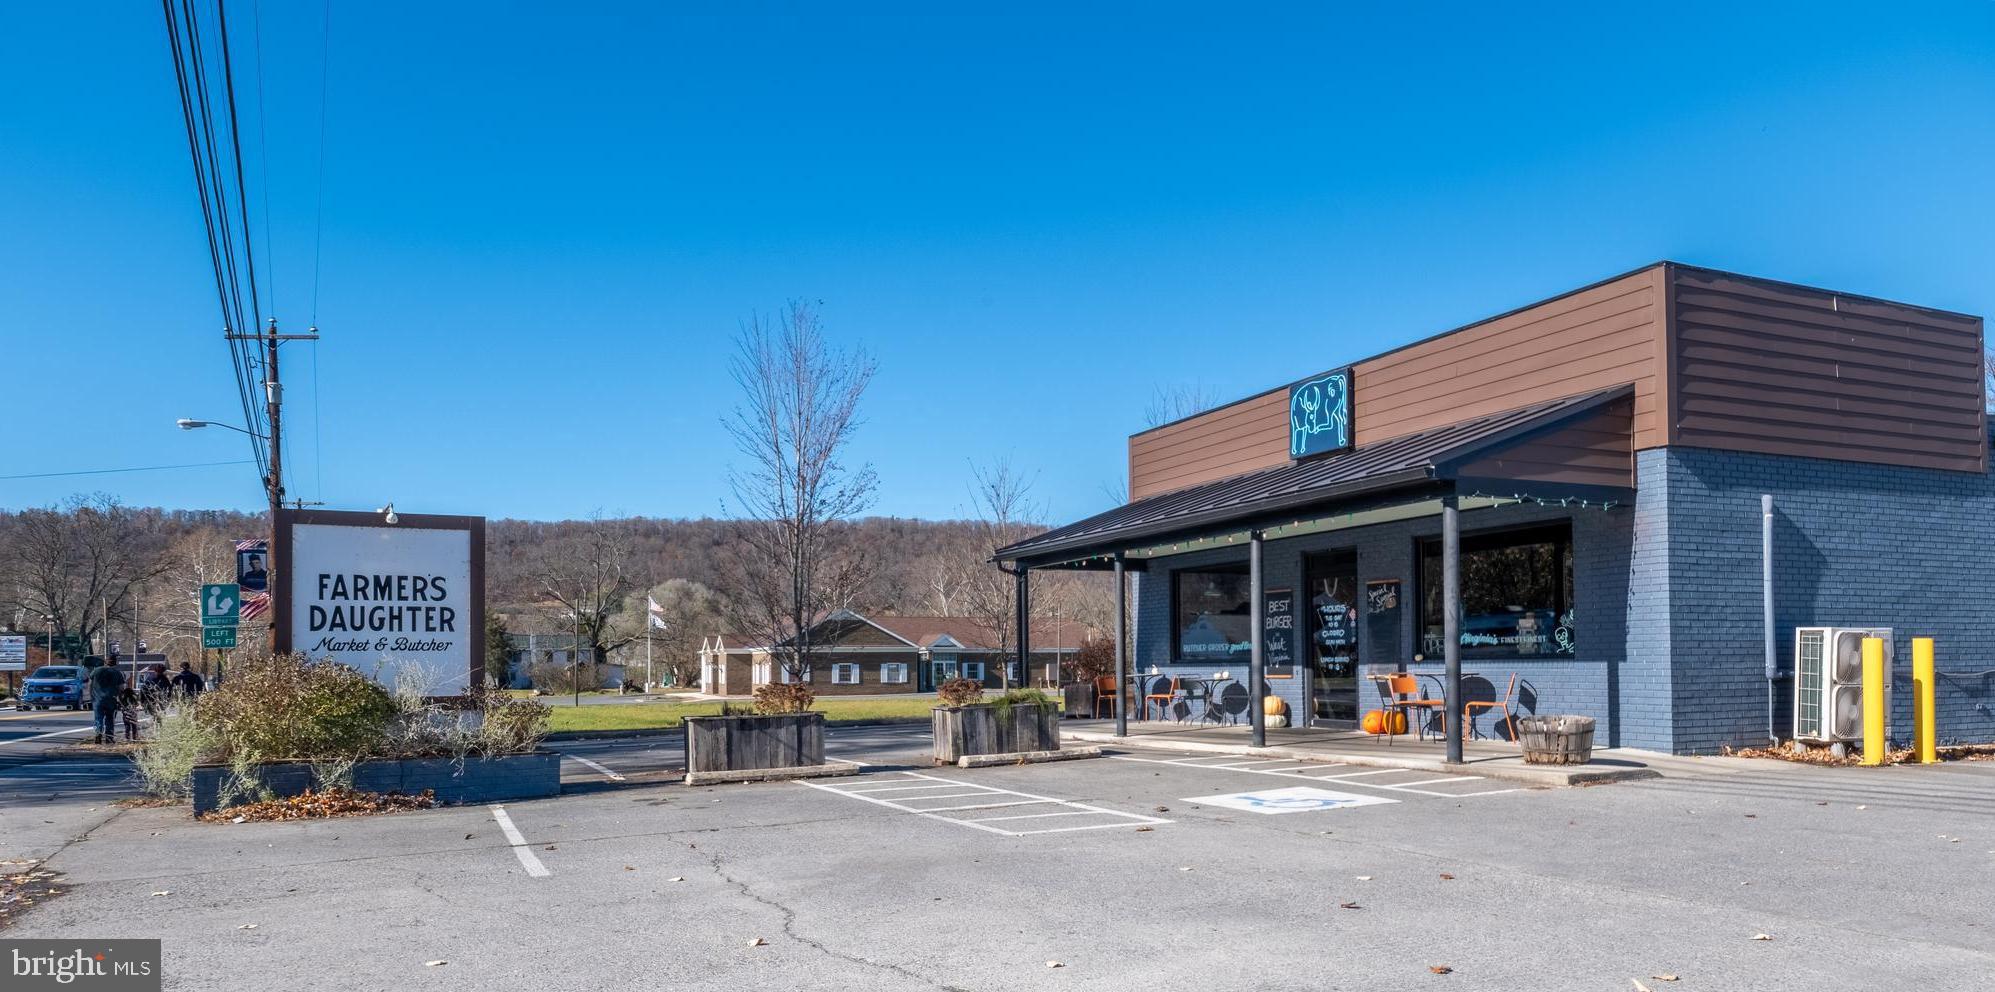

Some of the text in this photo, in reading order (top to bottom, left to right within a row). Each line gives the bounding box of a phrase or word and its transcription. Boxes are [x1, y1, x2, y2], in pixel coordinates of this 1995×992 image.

[1268, 600, 1290, 613] BEST
[309, 605, 456, 632] DAUGHTER
[1266, 615, 1292, 629] BURGER
[312, 636, 453, 652] Market & Butcher
[1267, 636, 1288, 651] West
